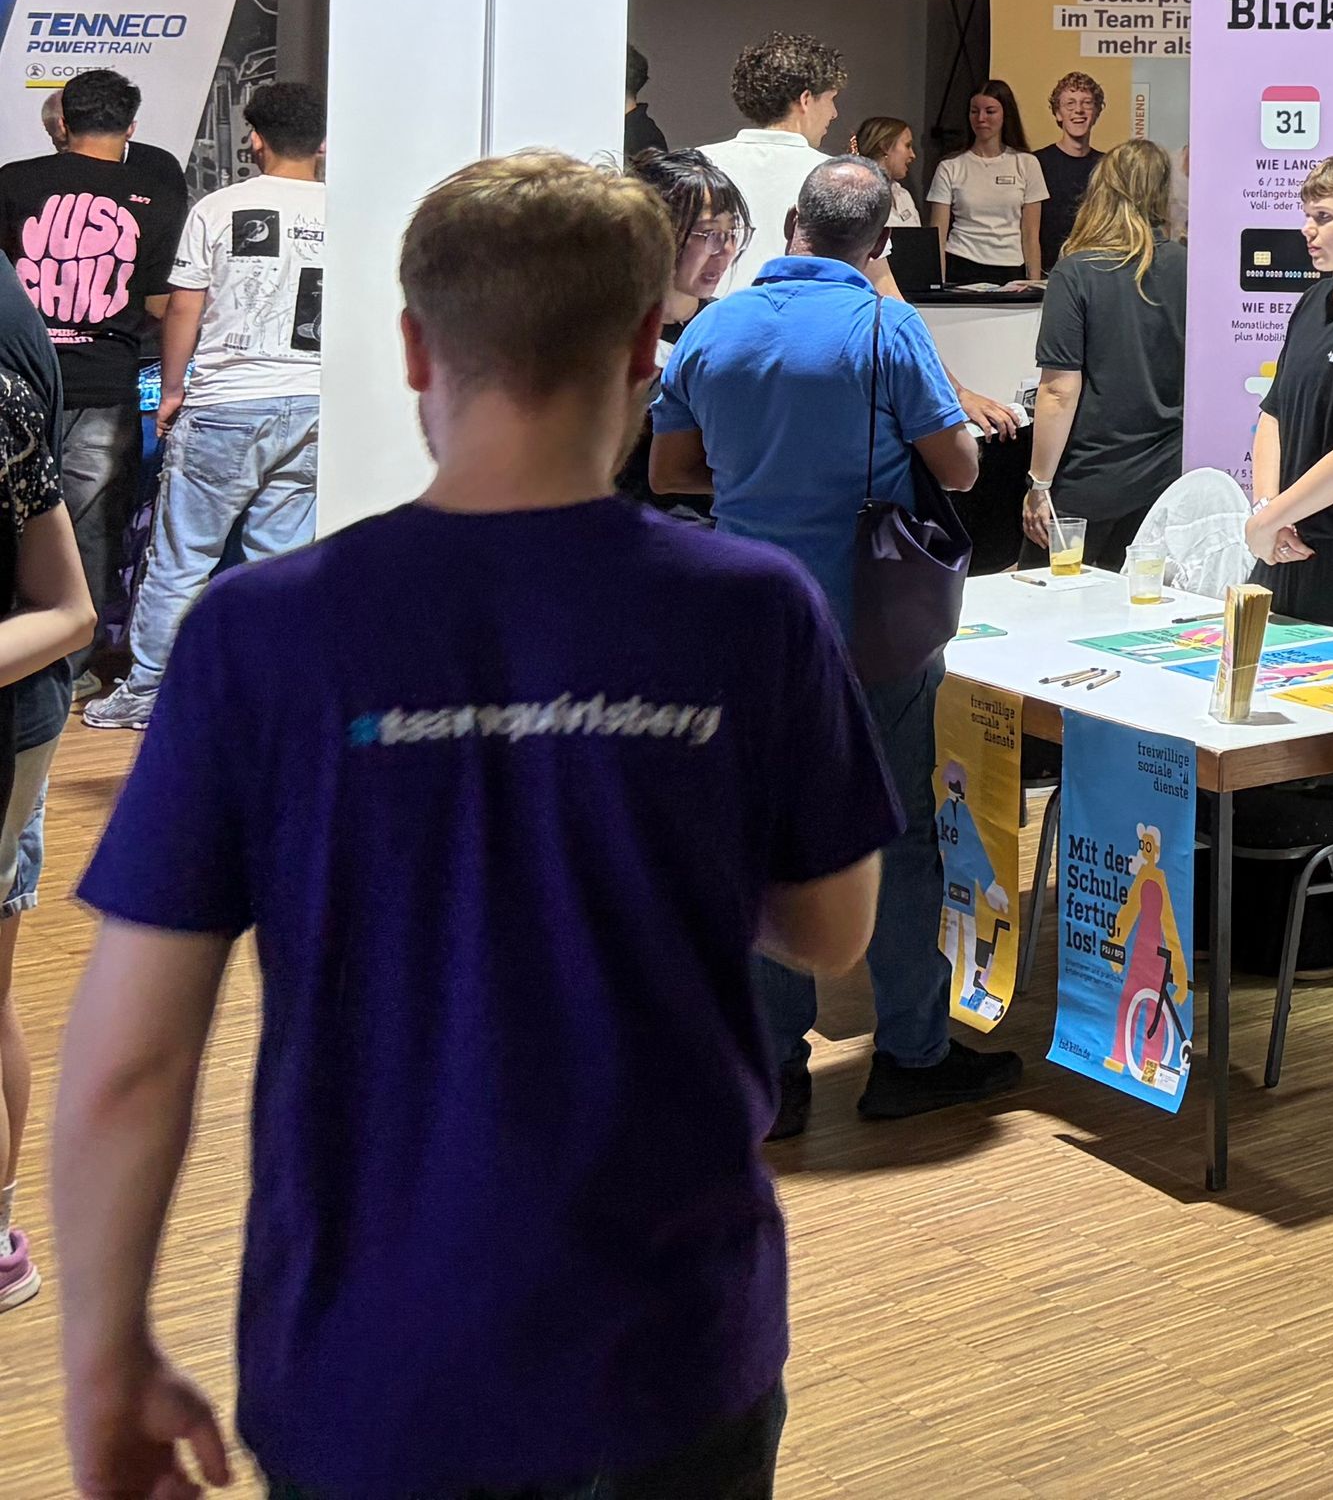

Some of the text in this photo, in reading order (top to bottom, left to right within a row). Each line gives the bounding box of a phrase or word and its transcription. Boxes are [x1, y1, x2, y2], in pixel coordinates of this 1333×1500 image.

[27, 12, 187, 38] TENNECO
[1061, 9, 1154, 28] im Team
[27, 41, 152, 54] POWERTRAIN
[1098, 36, 1157, 54] mehr
[1276, 110, 1306, 134] 31
[1256, 159, 1280, 171] WIE
[1250, 201, 1293, 211] Voll- oder
[22, 192, 141, 262] JUST
[16, 254, 135, 324] CHILL
[1242, 303, 1266, 314] WIE
[1231, 320, 1284, 331] Monatliches
[1234, 332, 1253, 343] plus
[1137, 740, 1190, 768] freiwillige
[1137, 759, 1172, 779] soziale
[1153, 778, 1189, 800] dienste
[1068, 834, 1134, 876] Mit der
[1066, 864, 1129, 906] Schule
[1066, 897, 1122, 940] fertig,
[1066, 921, 1097, 956] los!
